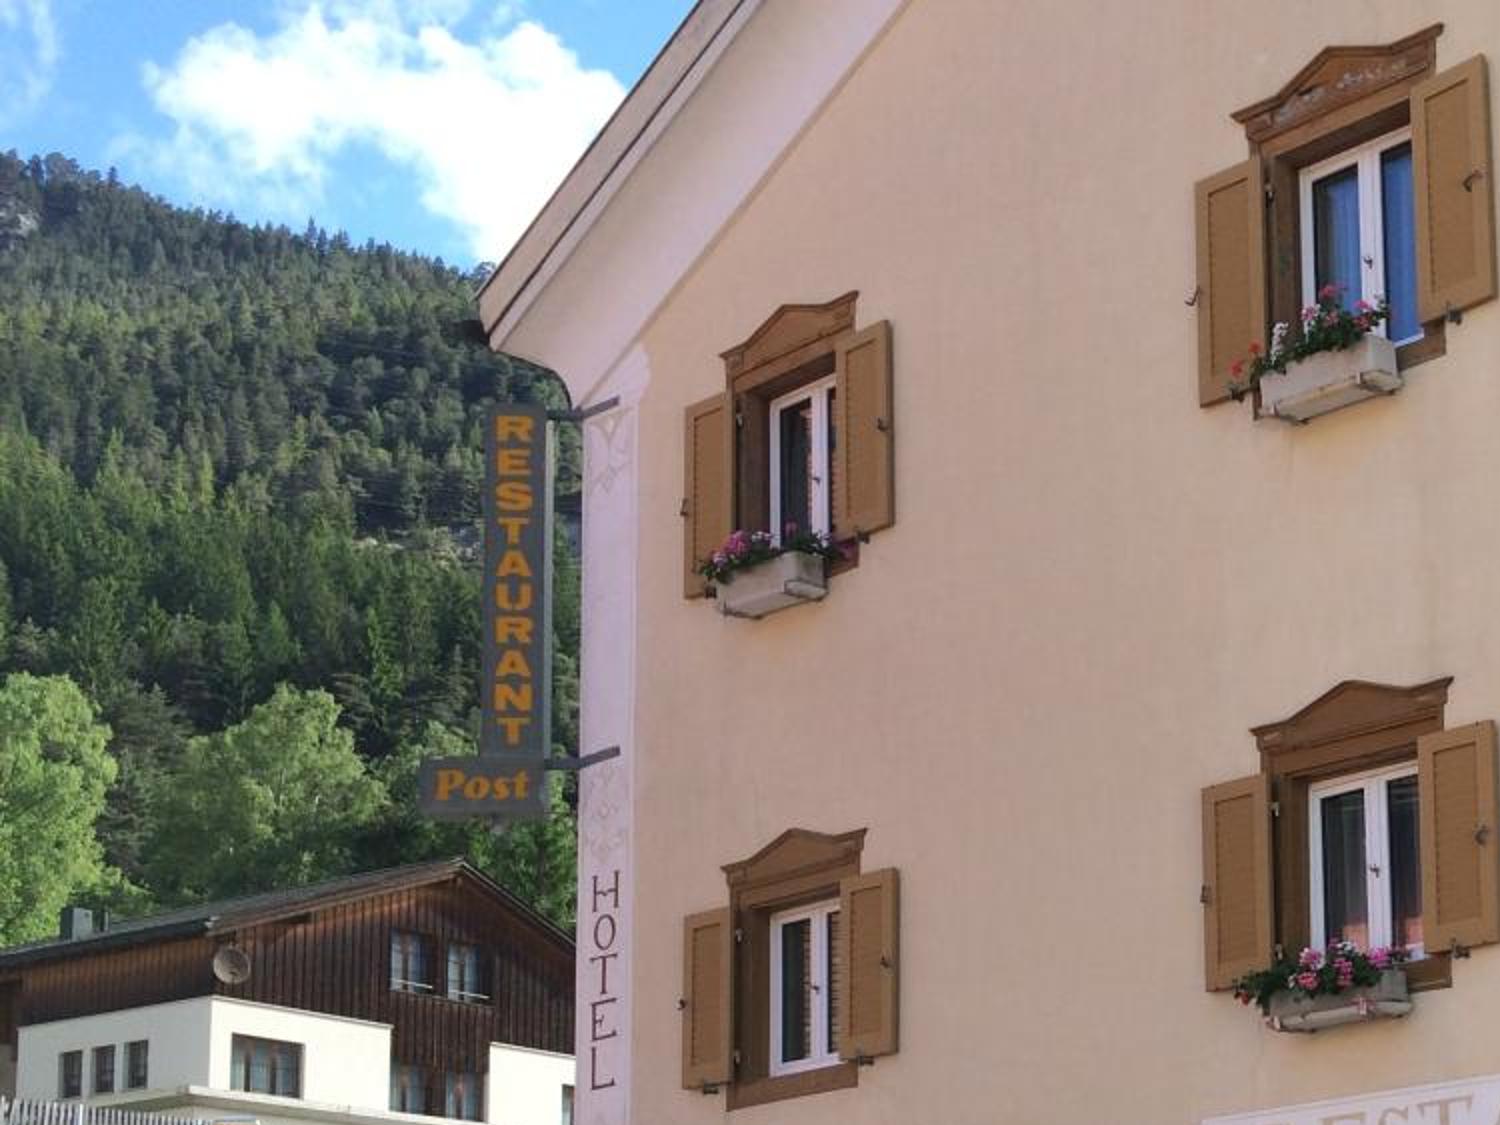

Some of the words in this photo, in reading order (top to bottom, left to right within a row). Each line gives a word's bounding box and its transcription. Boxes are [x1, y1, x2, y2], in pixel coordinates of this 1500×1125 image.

[495, 414, 535, 746] RESTAURANT
[434, 768, 530, 800] Post
[589, 869, 621, 1091] HOTEL
